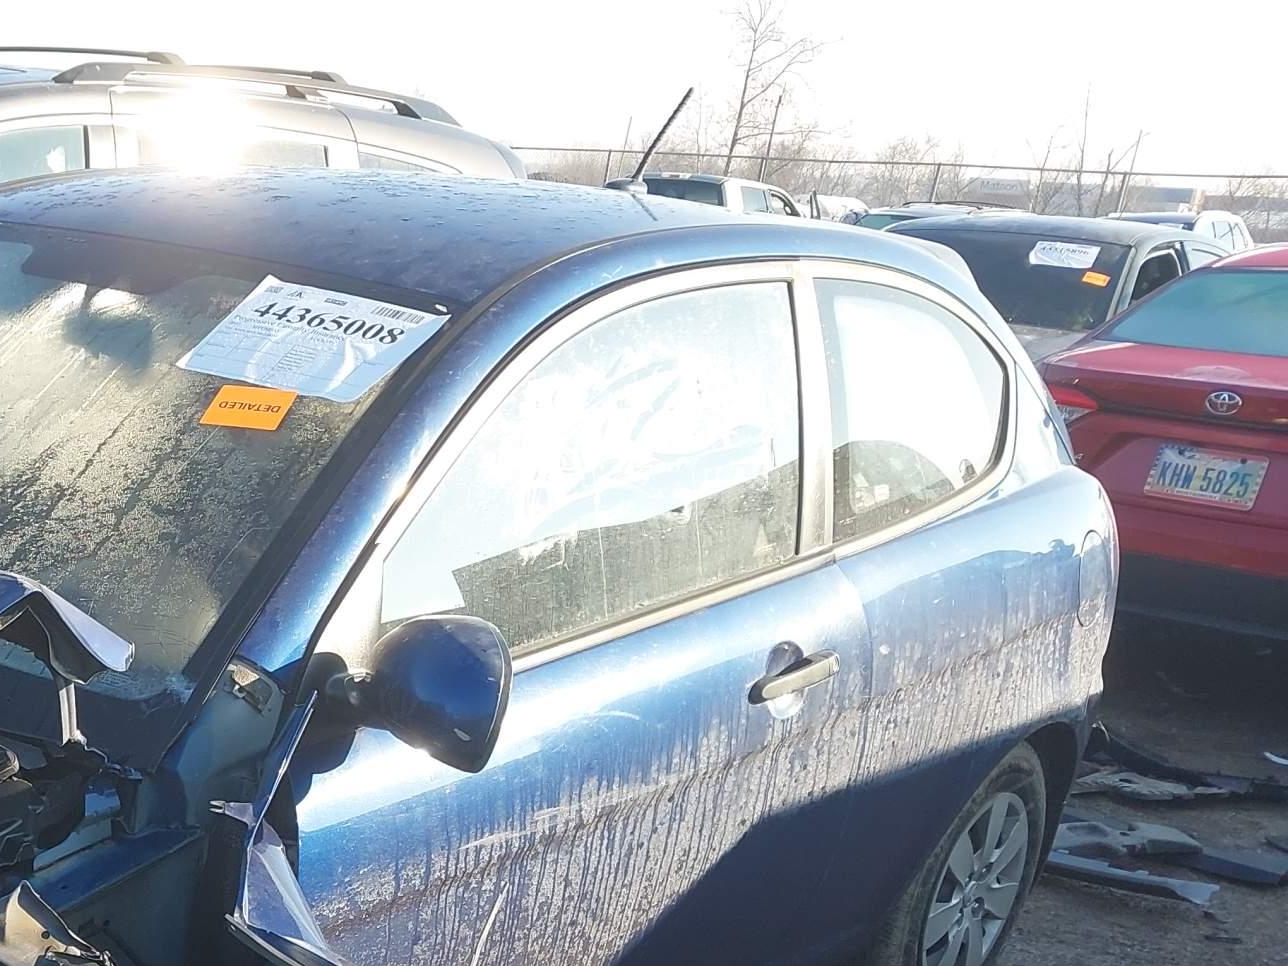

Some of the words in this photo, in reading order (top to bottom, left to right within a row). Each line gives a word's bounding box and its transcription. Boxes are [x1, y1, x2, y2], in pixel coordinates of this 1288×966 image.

[254, 302, 405, 345] 44365008
[219, 401, 281, 413] DETAILED
[1157, 462, 1196, 488] KHW
[1200, 468, 1251, 497] 5825
